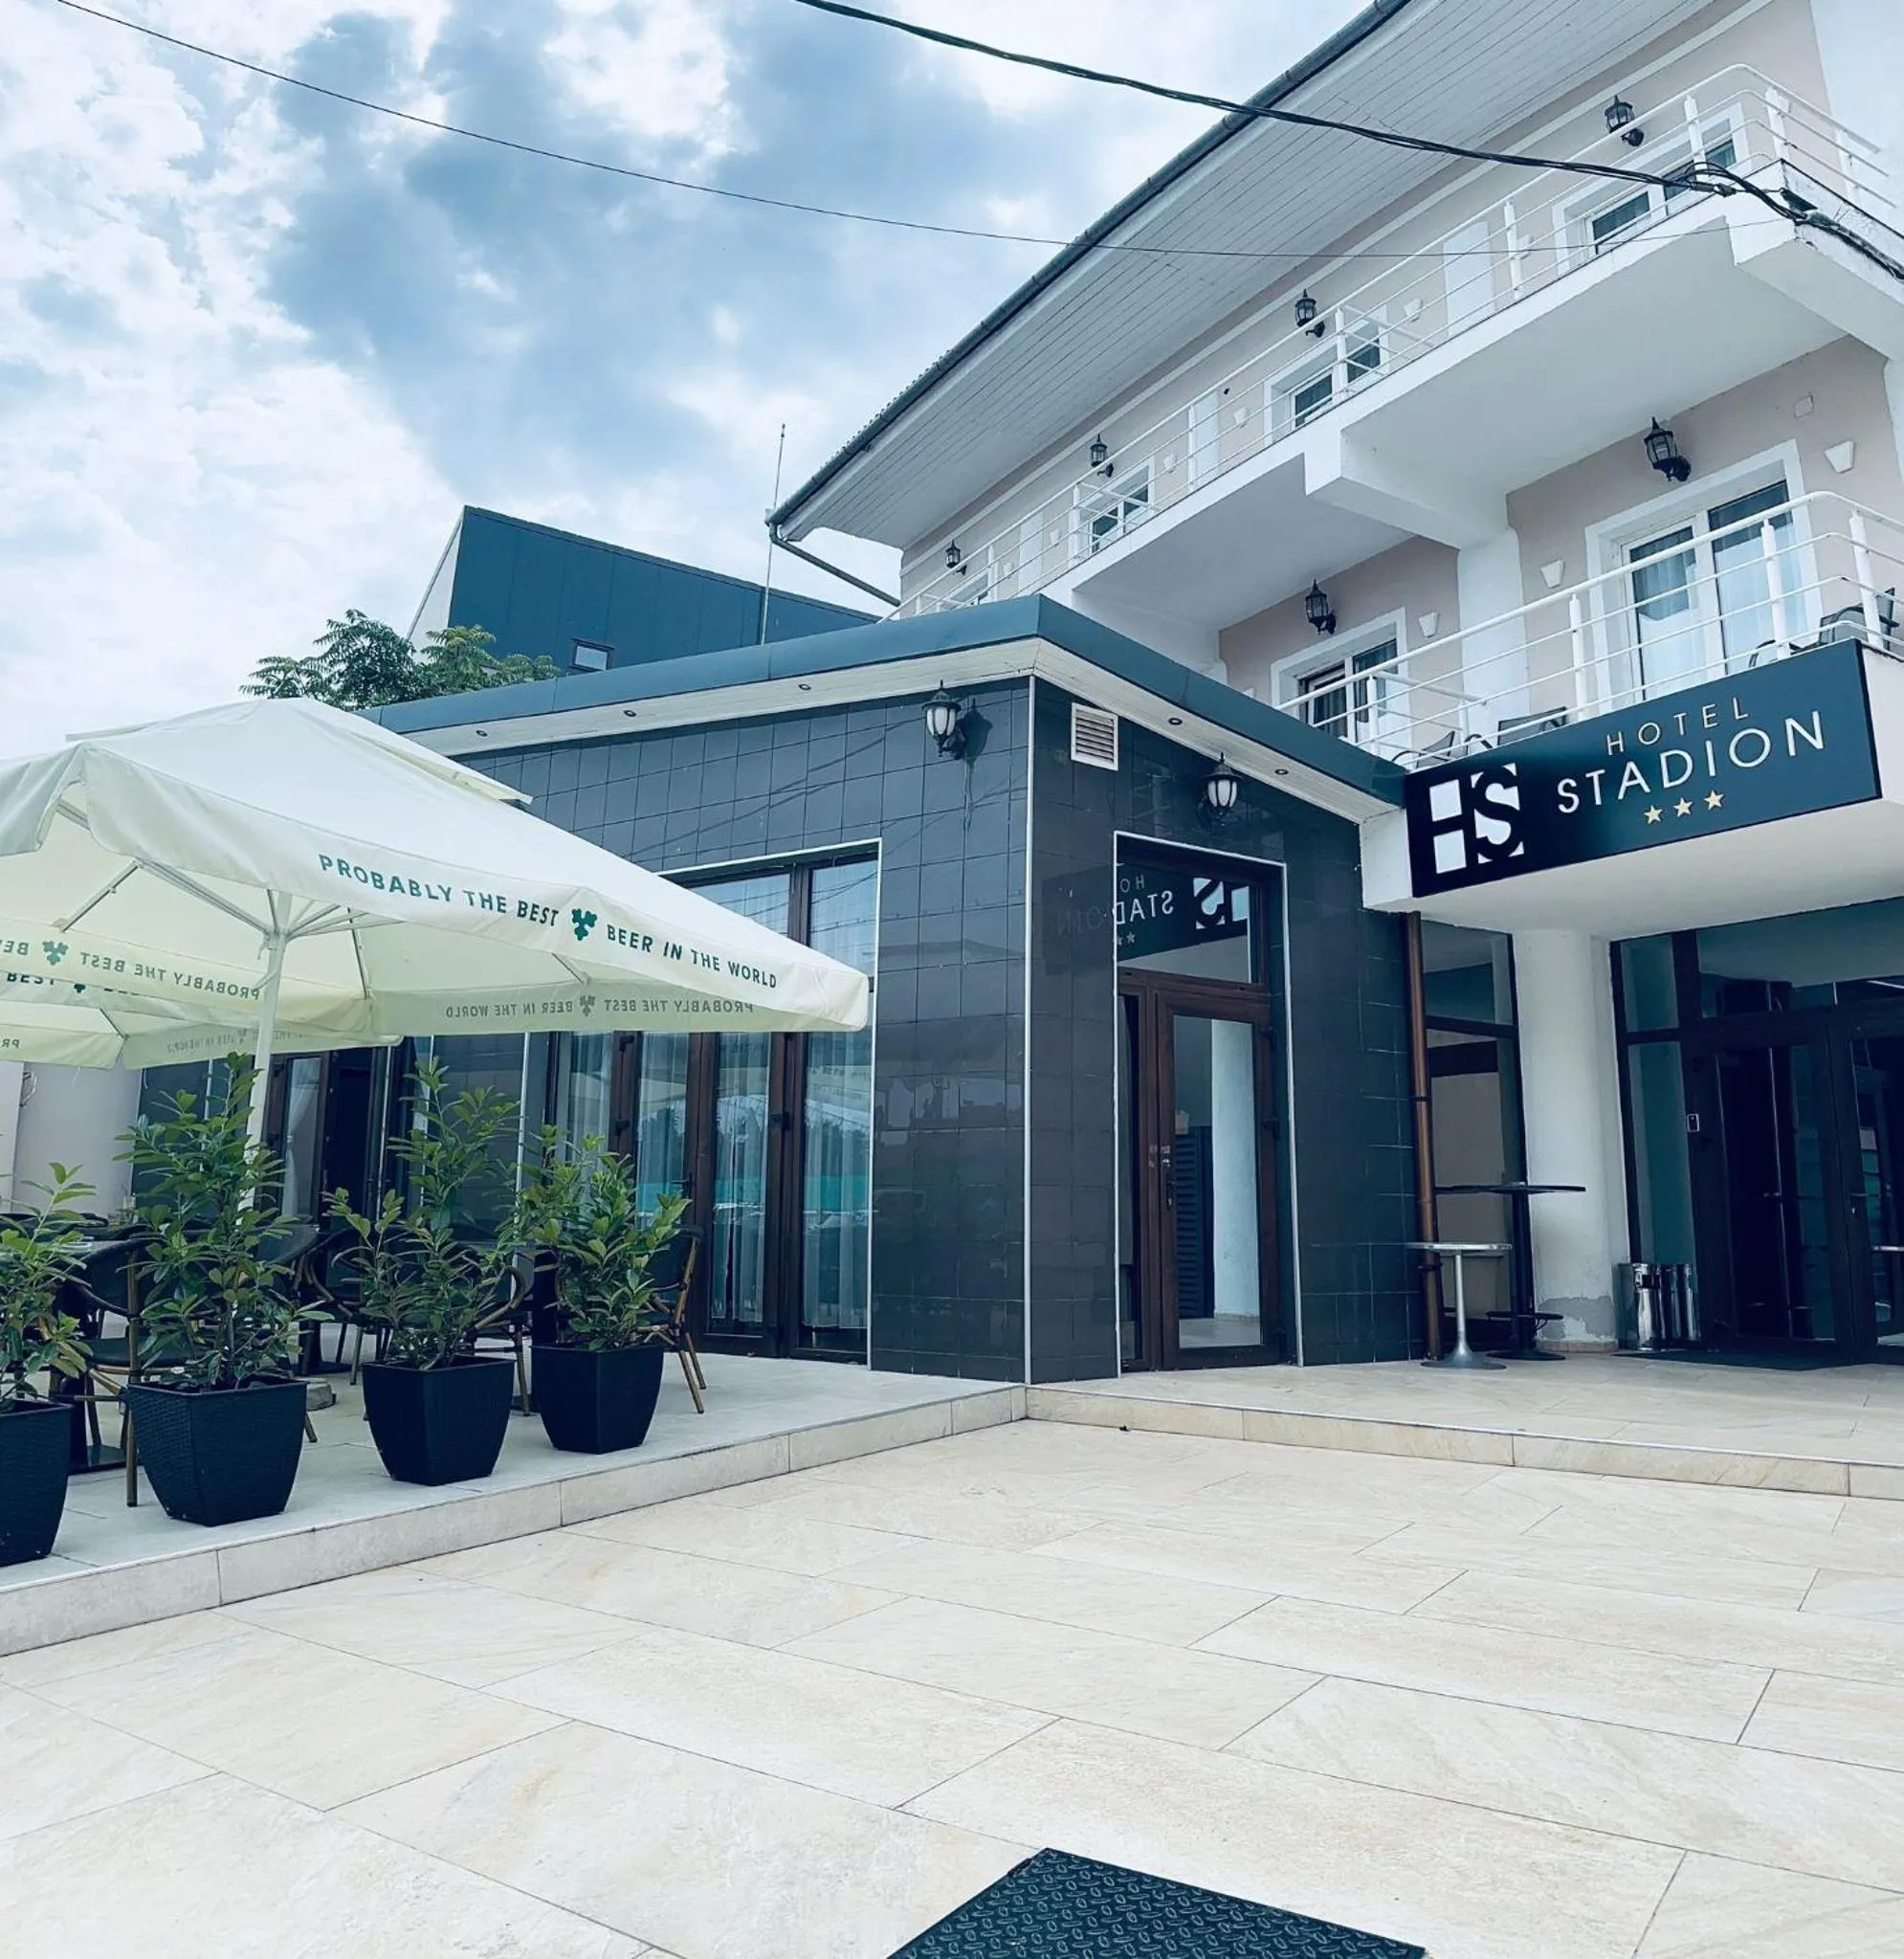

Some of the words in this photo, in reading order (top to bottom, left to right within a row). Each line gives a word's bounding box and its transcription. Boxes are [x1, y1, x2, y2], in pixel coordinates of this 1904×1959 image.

[1557, 710, 1825, 813] STADION
[1605, 696, 1750, 757] HOTEL
[319, 854, 452, 902] PROBABLY
[463, 890, 507, 914] THE
[517, 900, 560, 926] BEST
[607, 924, 653, 952] BEER
[663, 942, 683, 961] IN
[690, 948, 720, 972] THE
[727, 960, 777, 989] WORLD
